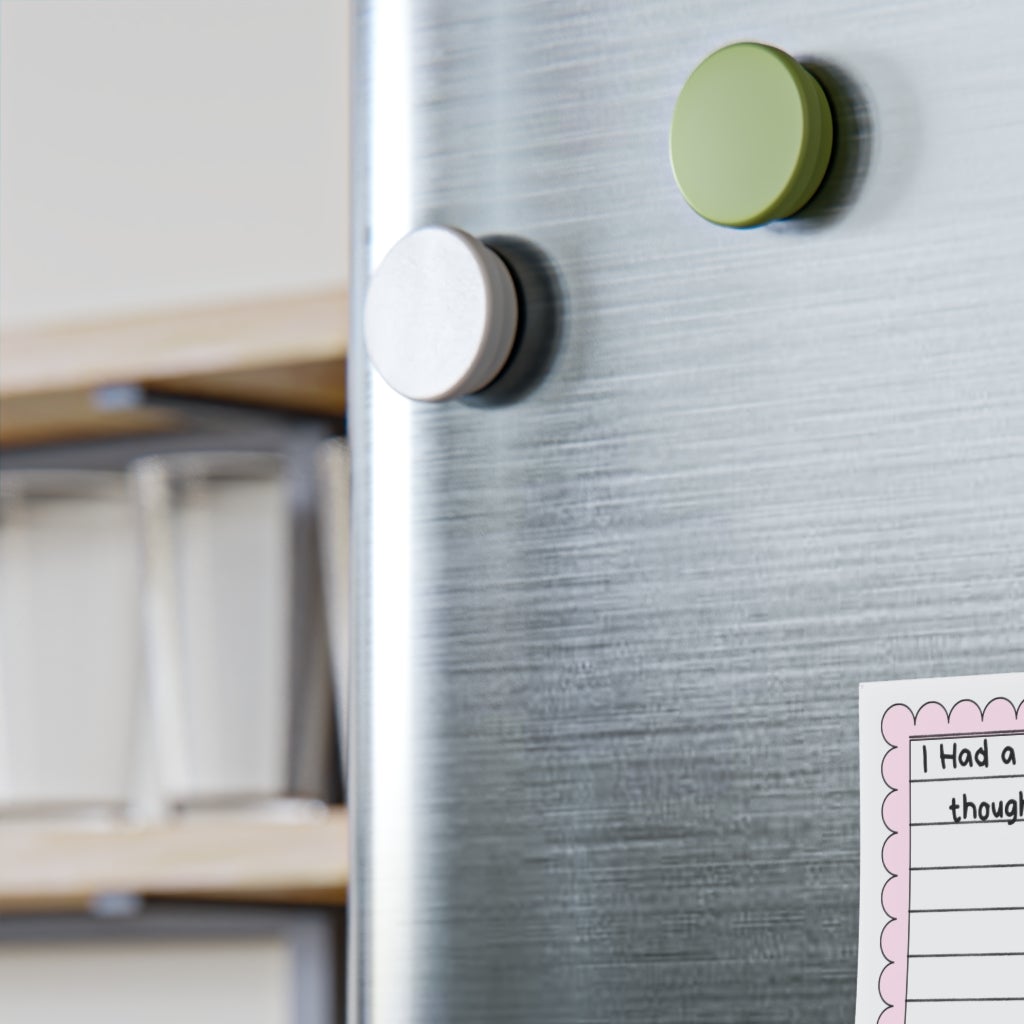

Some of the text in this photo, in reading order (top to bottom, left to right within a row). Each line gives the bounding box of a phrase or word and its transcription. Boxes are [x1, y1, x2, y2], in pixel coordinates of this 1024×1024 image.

[922, 738, 1017, 774] I Had a
